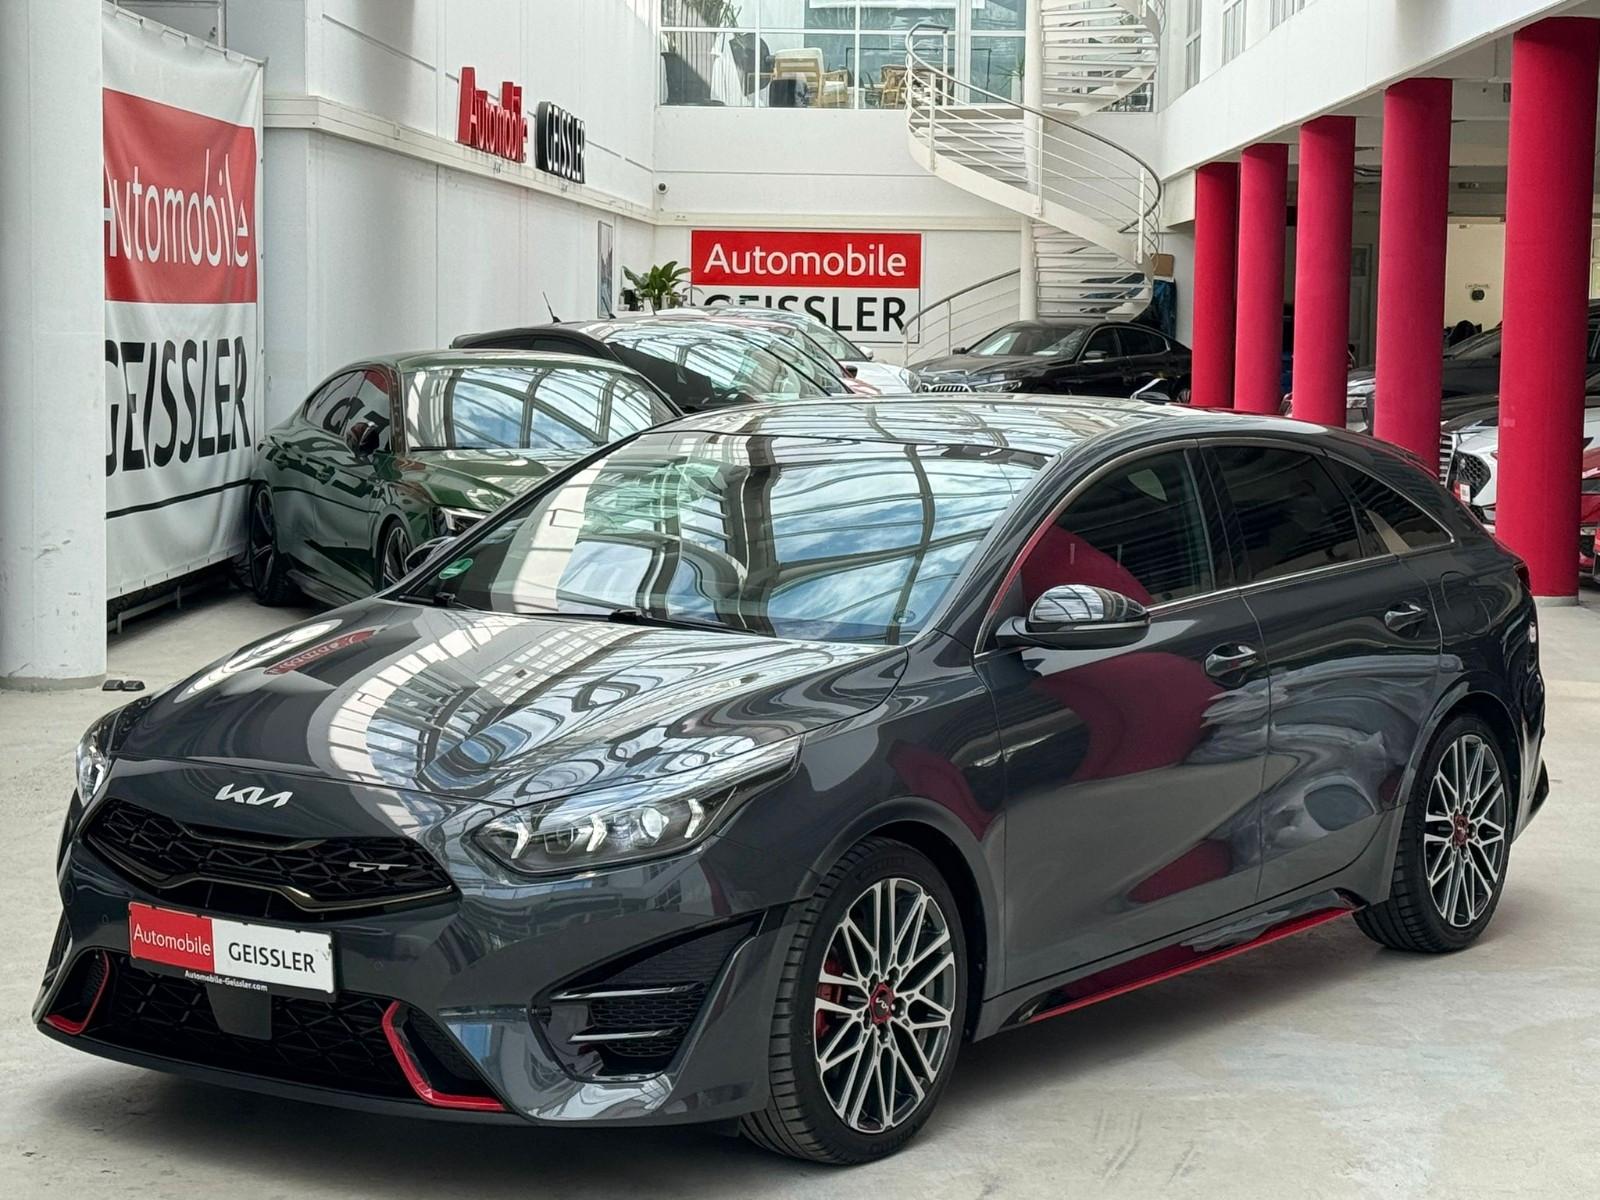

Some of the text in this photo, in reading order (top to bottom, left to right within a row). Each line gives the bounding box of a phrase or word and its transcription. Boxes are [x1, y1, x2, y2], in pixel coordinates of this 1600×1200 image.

[535, 101, 586, 184] GEISSLER
[703, 243, 907, 276] Automobile
[703, 294, 906, 332] SLER
[214, 783, 293, 808] KIA
[348, 861, 409, 873] GT
[133, 923, 316, 974] Automobile GEISSLER
[184, 969, 268, 992] Automobile-Geissler.com
